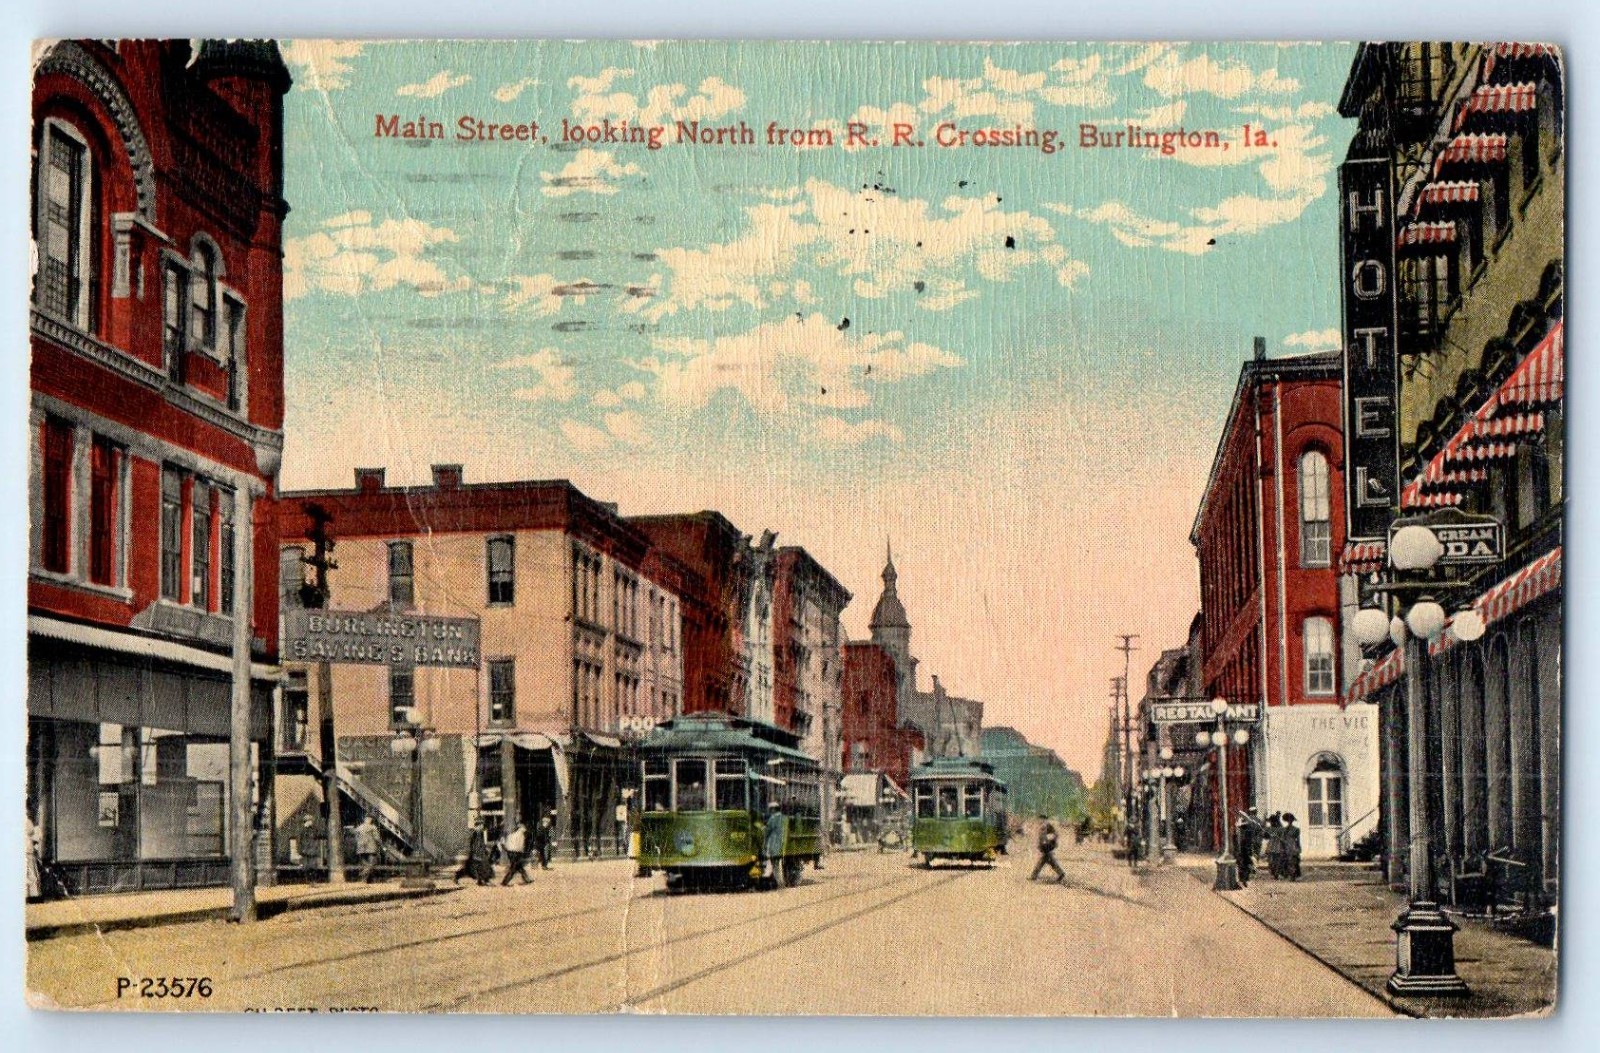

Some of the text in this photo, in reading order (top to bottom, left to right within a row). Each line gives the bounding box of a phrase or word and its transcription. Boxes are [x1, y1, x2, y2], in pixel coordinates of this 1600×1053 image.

[1350, 185, 1391, 508] HOTEL
[1438, 529, 1493, 541] CREAM
[309, 615, 463, 639] BURLINGTON
[414, 646, 475, 665] BANK
[1156, 705, 1257, 720] RESTAUANT
[1311, 717, 1335, 730] THE
